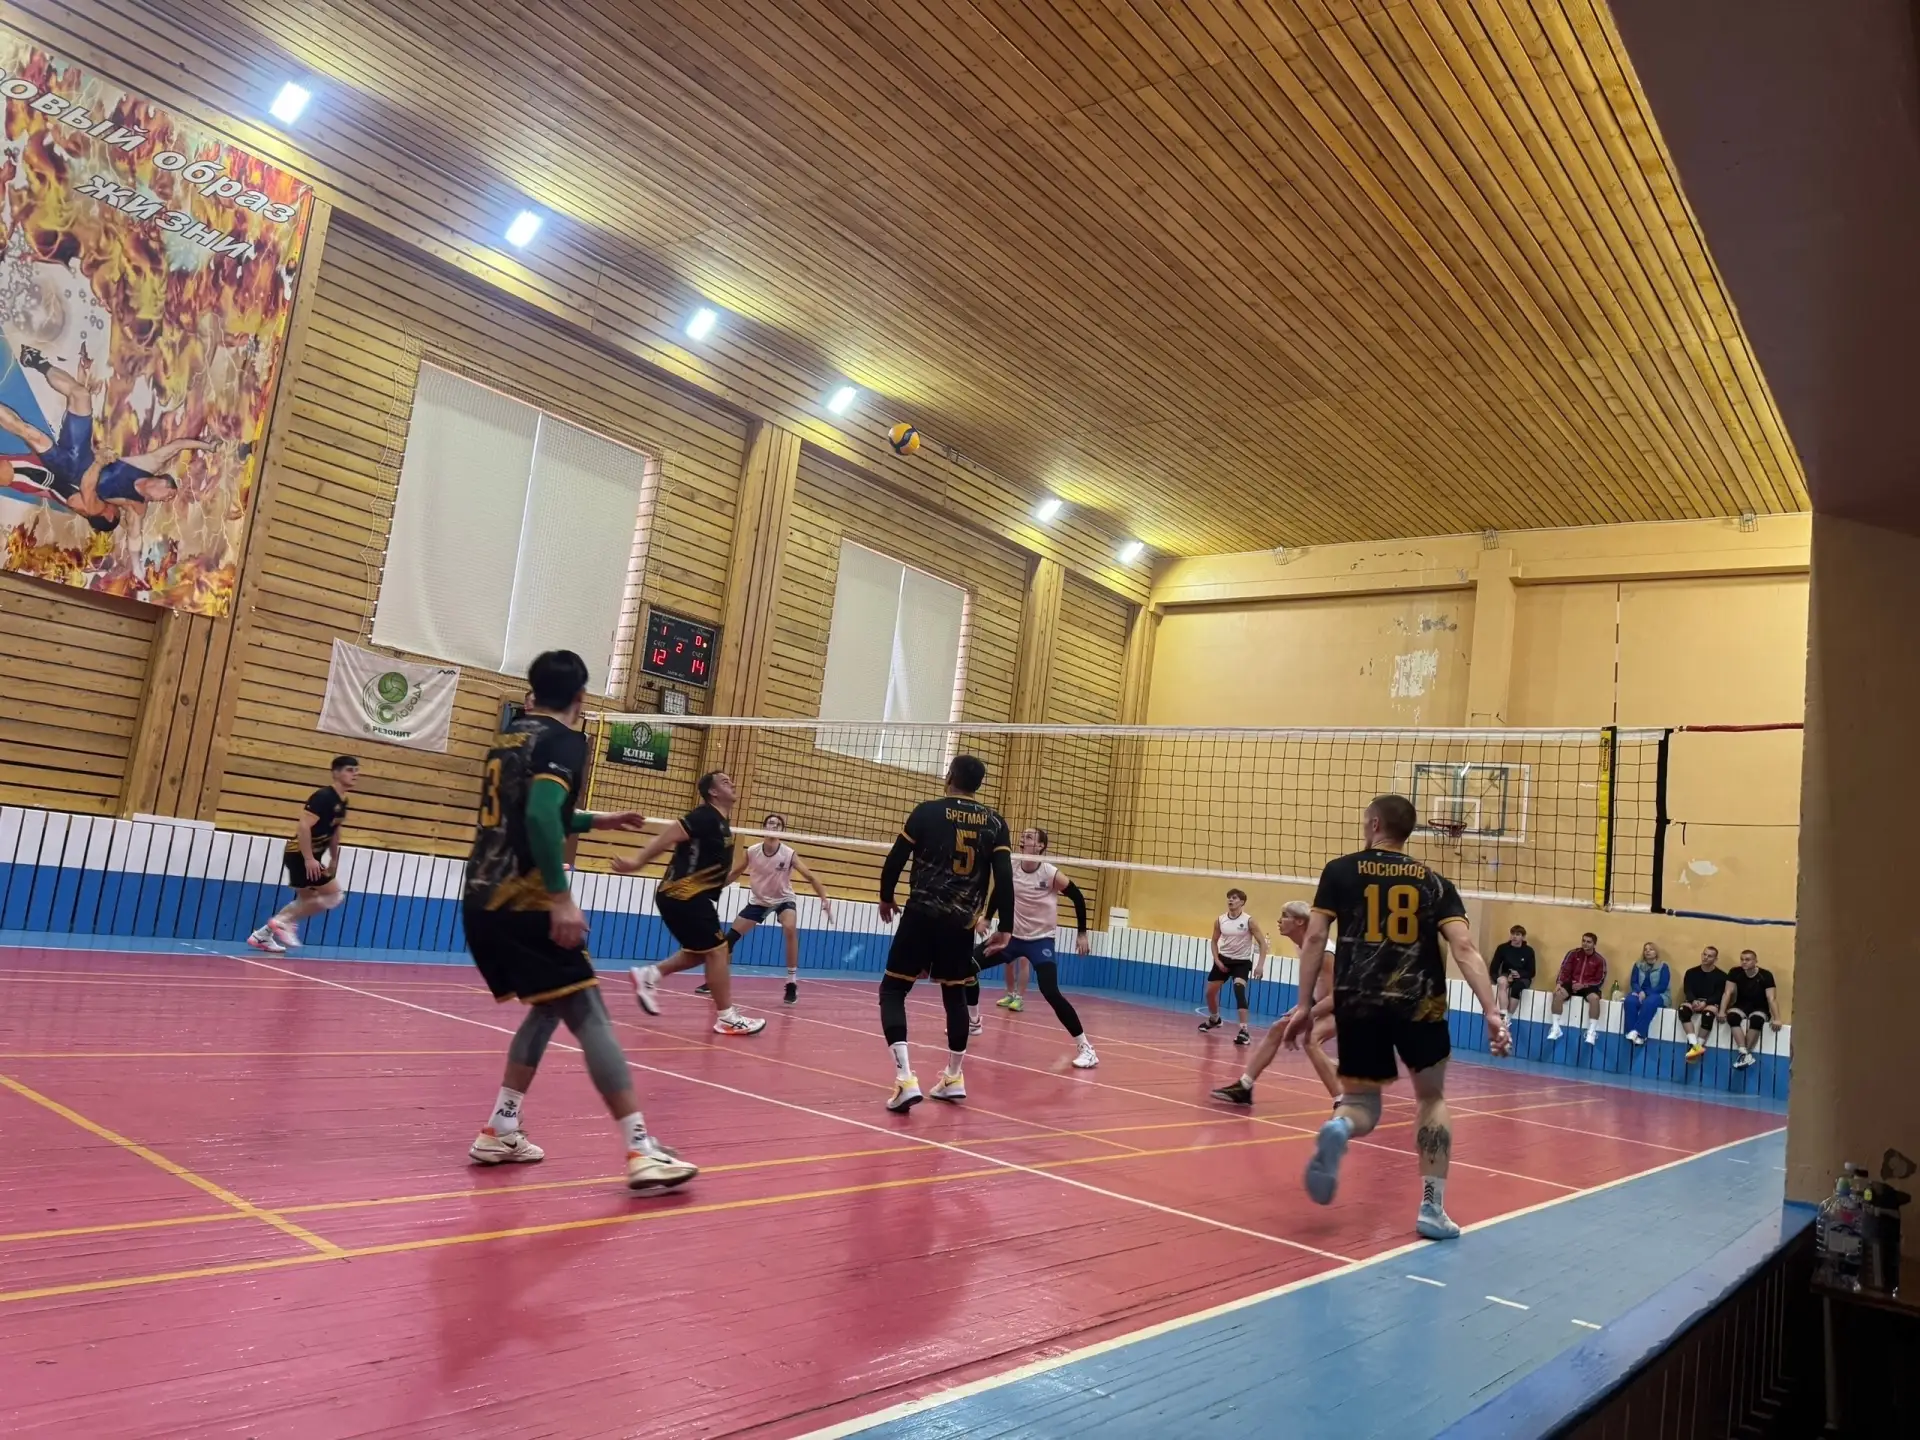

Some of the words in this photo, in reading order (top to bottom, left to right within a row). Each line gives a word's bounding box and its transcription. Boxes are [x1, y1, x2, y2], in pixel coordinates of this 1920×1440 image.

[0, 66, 148, 152] овый
[153, 151, 296, 224] образ
[73, 175, 249, 260] жизни
[675, 642, 683, 653] 2
[695, 635, 702, 646] 0
[652, 648, 667, 666] 12
[691, 659, 705, 676] 14
[373, 726, 412, 738] РЕЗОНИТ
[623, 746, 655, 761] КЛИН
[481, 758, 502, 828] 3
[945, 807, 988, 825] БРЕГМАН
[953, 828, 978, 876] 5
[1357, 860, 1426, 880] КОСЮКОВ
[1363, 883, 1419, 944] 18
